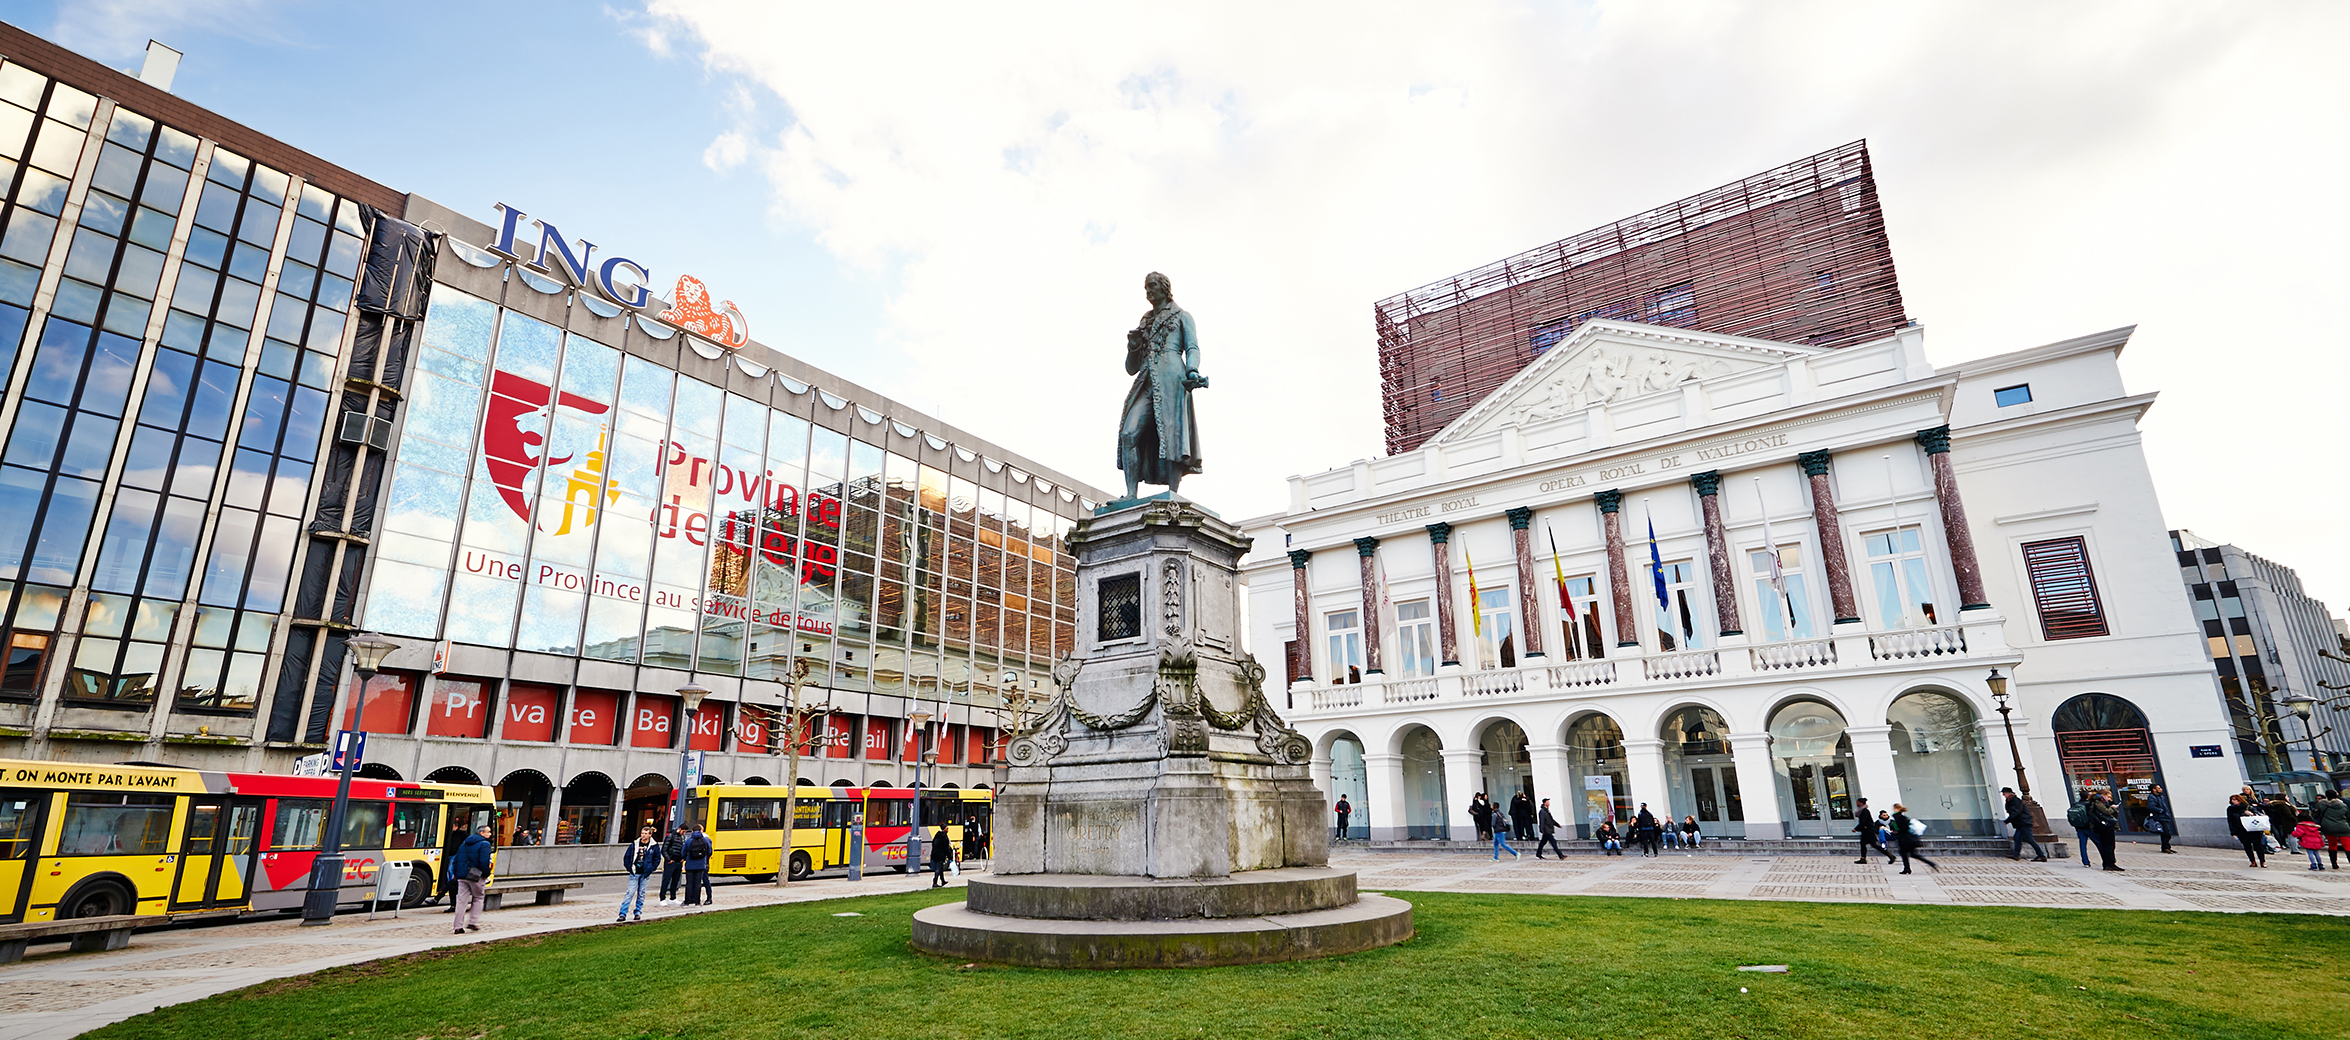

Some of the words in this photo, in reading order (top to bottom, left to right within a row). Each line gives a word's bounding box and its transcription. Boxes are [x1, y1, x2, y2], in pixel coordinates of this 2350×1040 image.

[485, 201, 654, 309] ING
[655, 439, 841, 529] Province
[1539, 475, 1586, 493] OPERA
[1599, 463, 1645, 481] ROYAL
[1660, 455, 1682, 469] DE
[1697, 433, 1788, 462] WALLONIE
[650, 494, 709, 546] de
[725, 510, 837, 585] Liège
[1376, 505, 1431, 526] THEATRE
[1441, 496, 1480, 513] ROYAL
[465, 550, 520, 580] Une
[540, 565, 641, 601] Province
[657, 591, 681, 609] au
[691, 595, 761, 624] service
[768, 606, 791, 630] de
[796, 614, 833, 636] tous
[828, 726, 886, 749] Reail
[16, 770, 39, 781] ON
[44, 772, 92, 784] MONTE
[98, 774, 123, 785] PAR
[128, 775, 177, 787] L'AVANT
